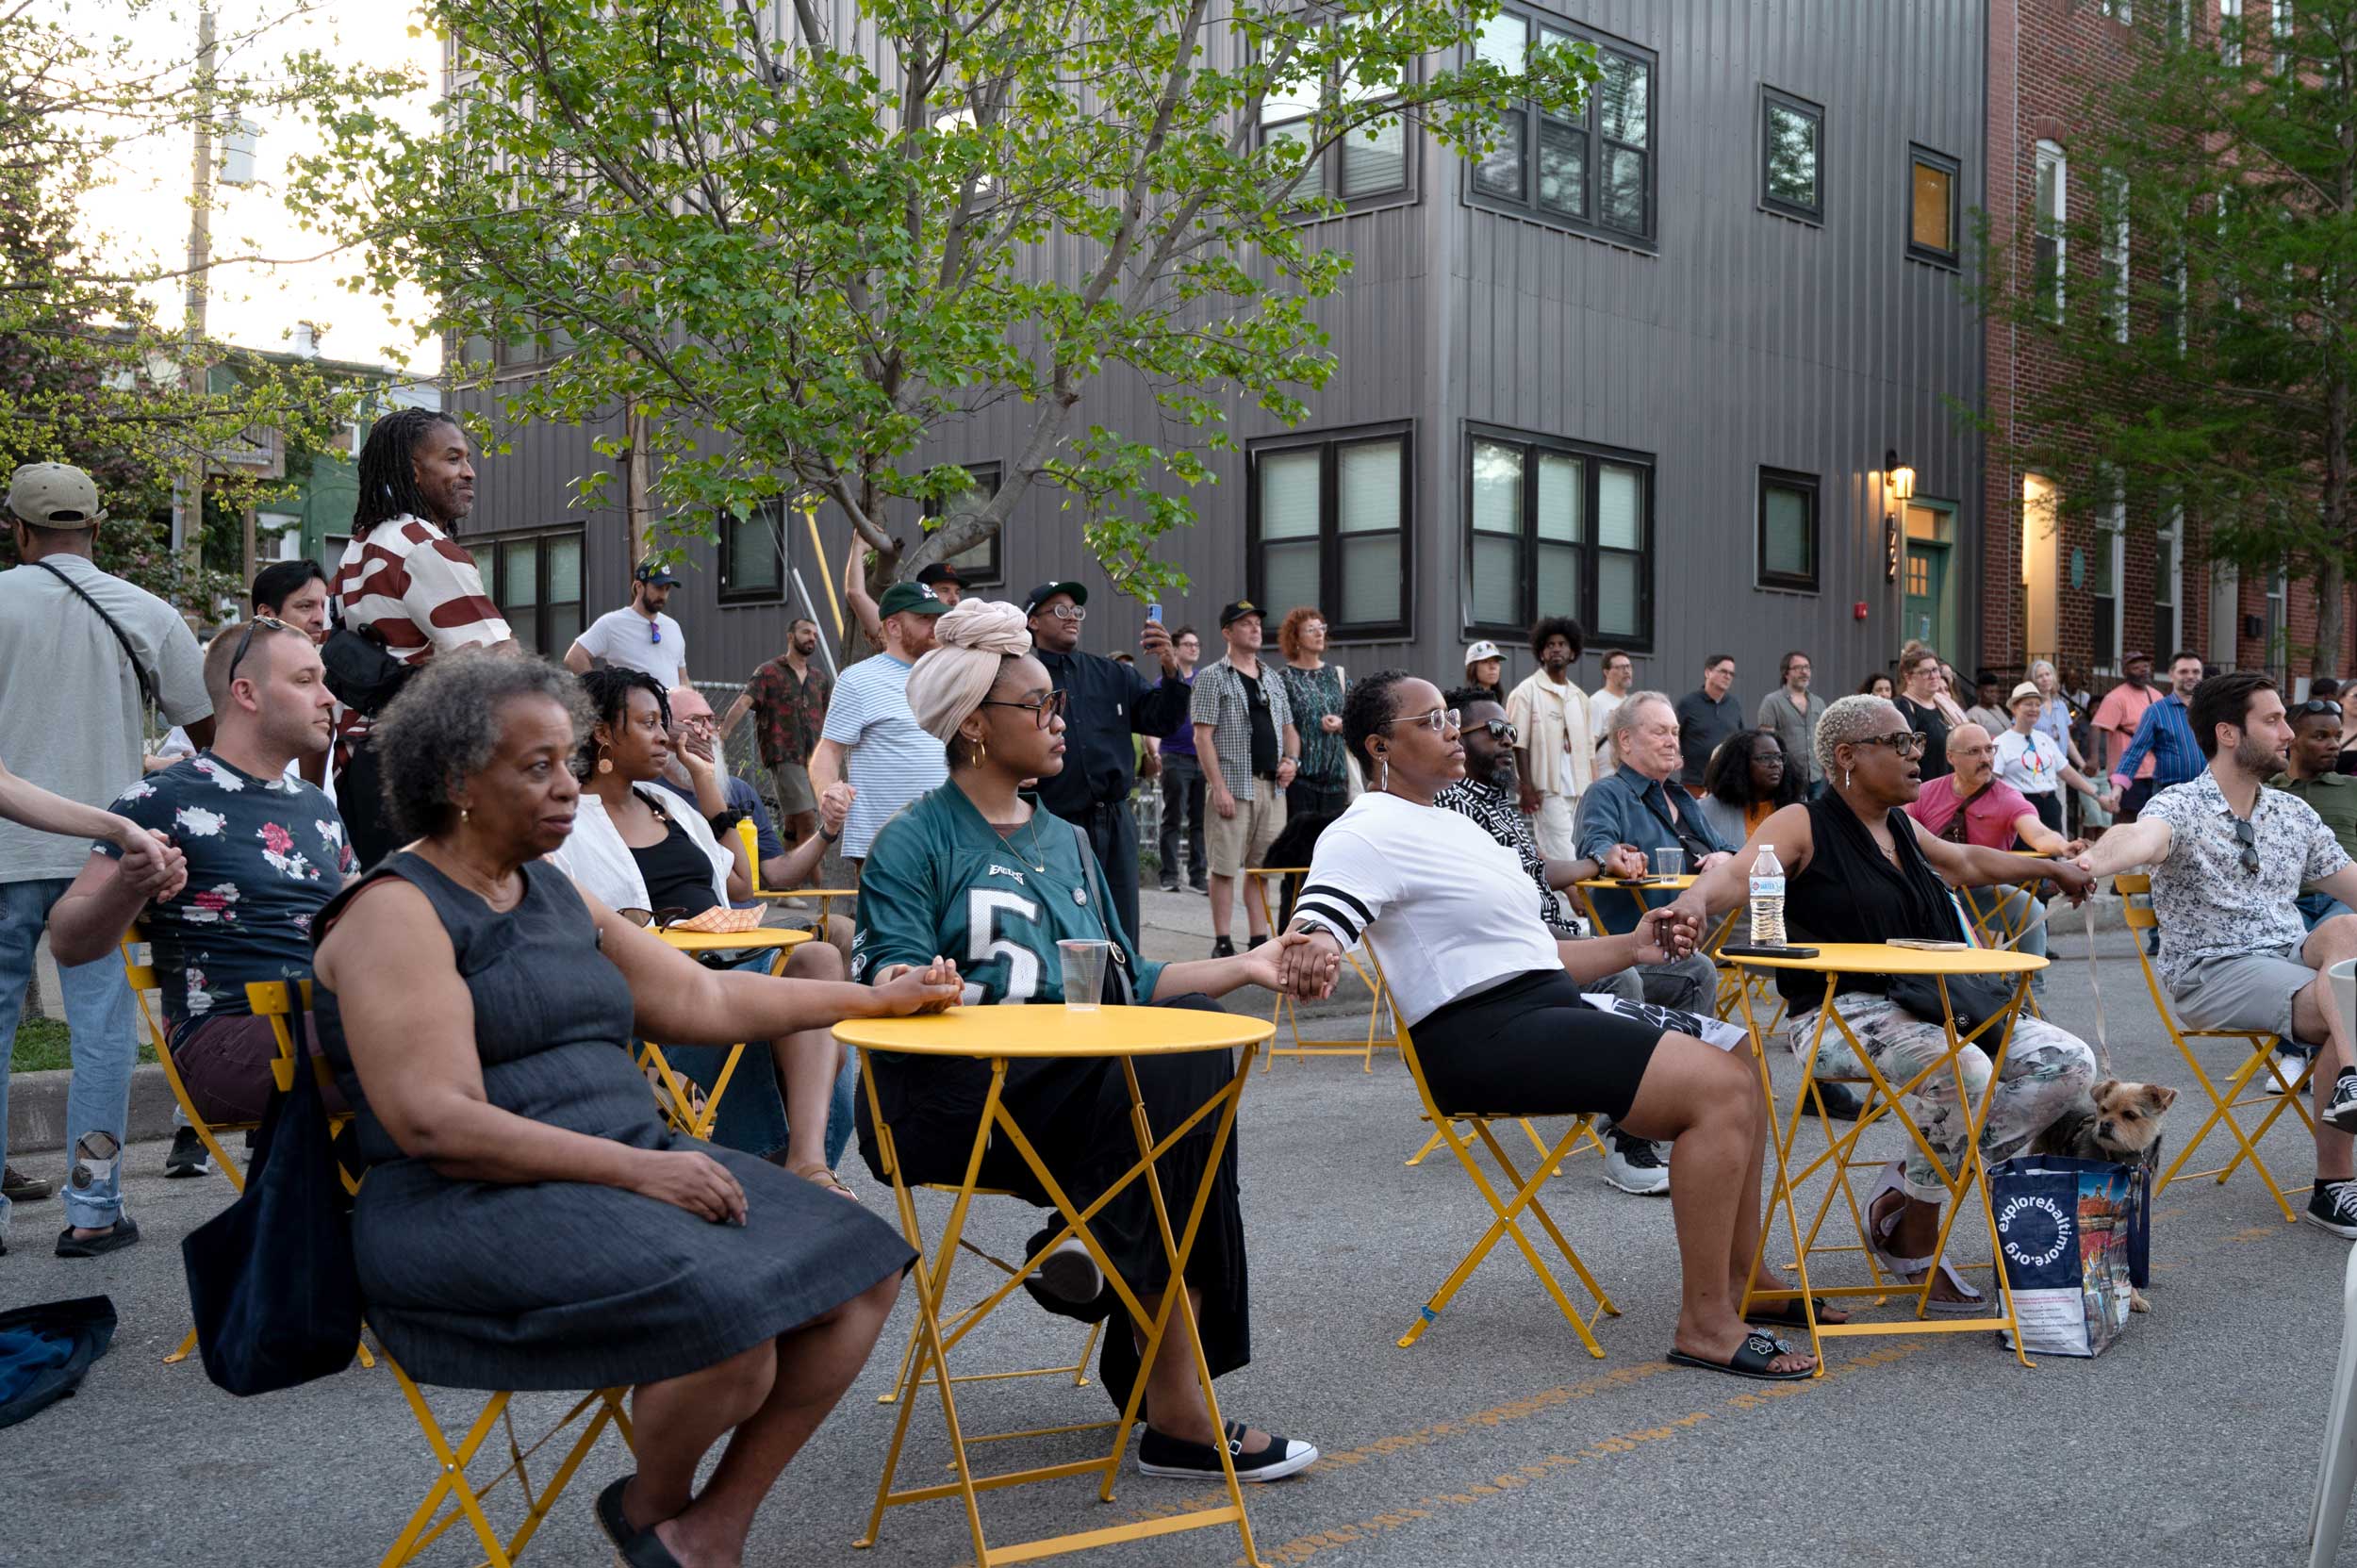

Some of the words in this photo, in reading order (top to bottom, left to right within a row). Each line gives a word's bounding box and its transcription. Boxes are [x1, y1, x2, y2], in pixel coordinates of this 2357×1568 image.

[988, 864, 1025, 885] EAGLES
[964, 887, 1038, 1005] 5
[1999, 1196, 2072, 1266] explorebaltimore.org
